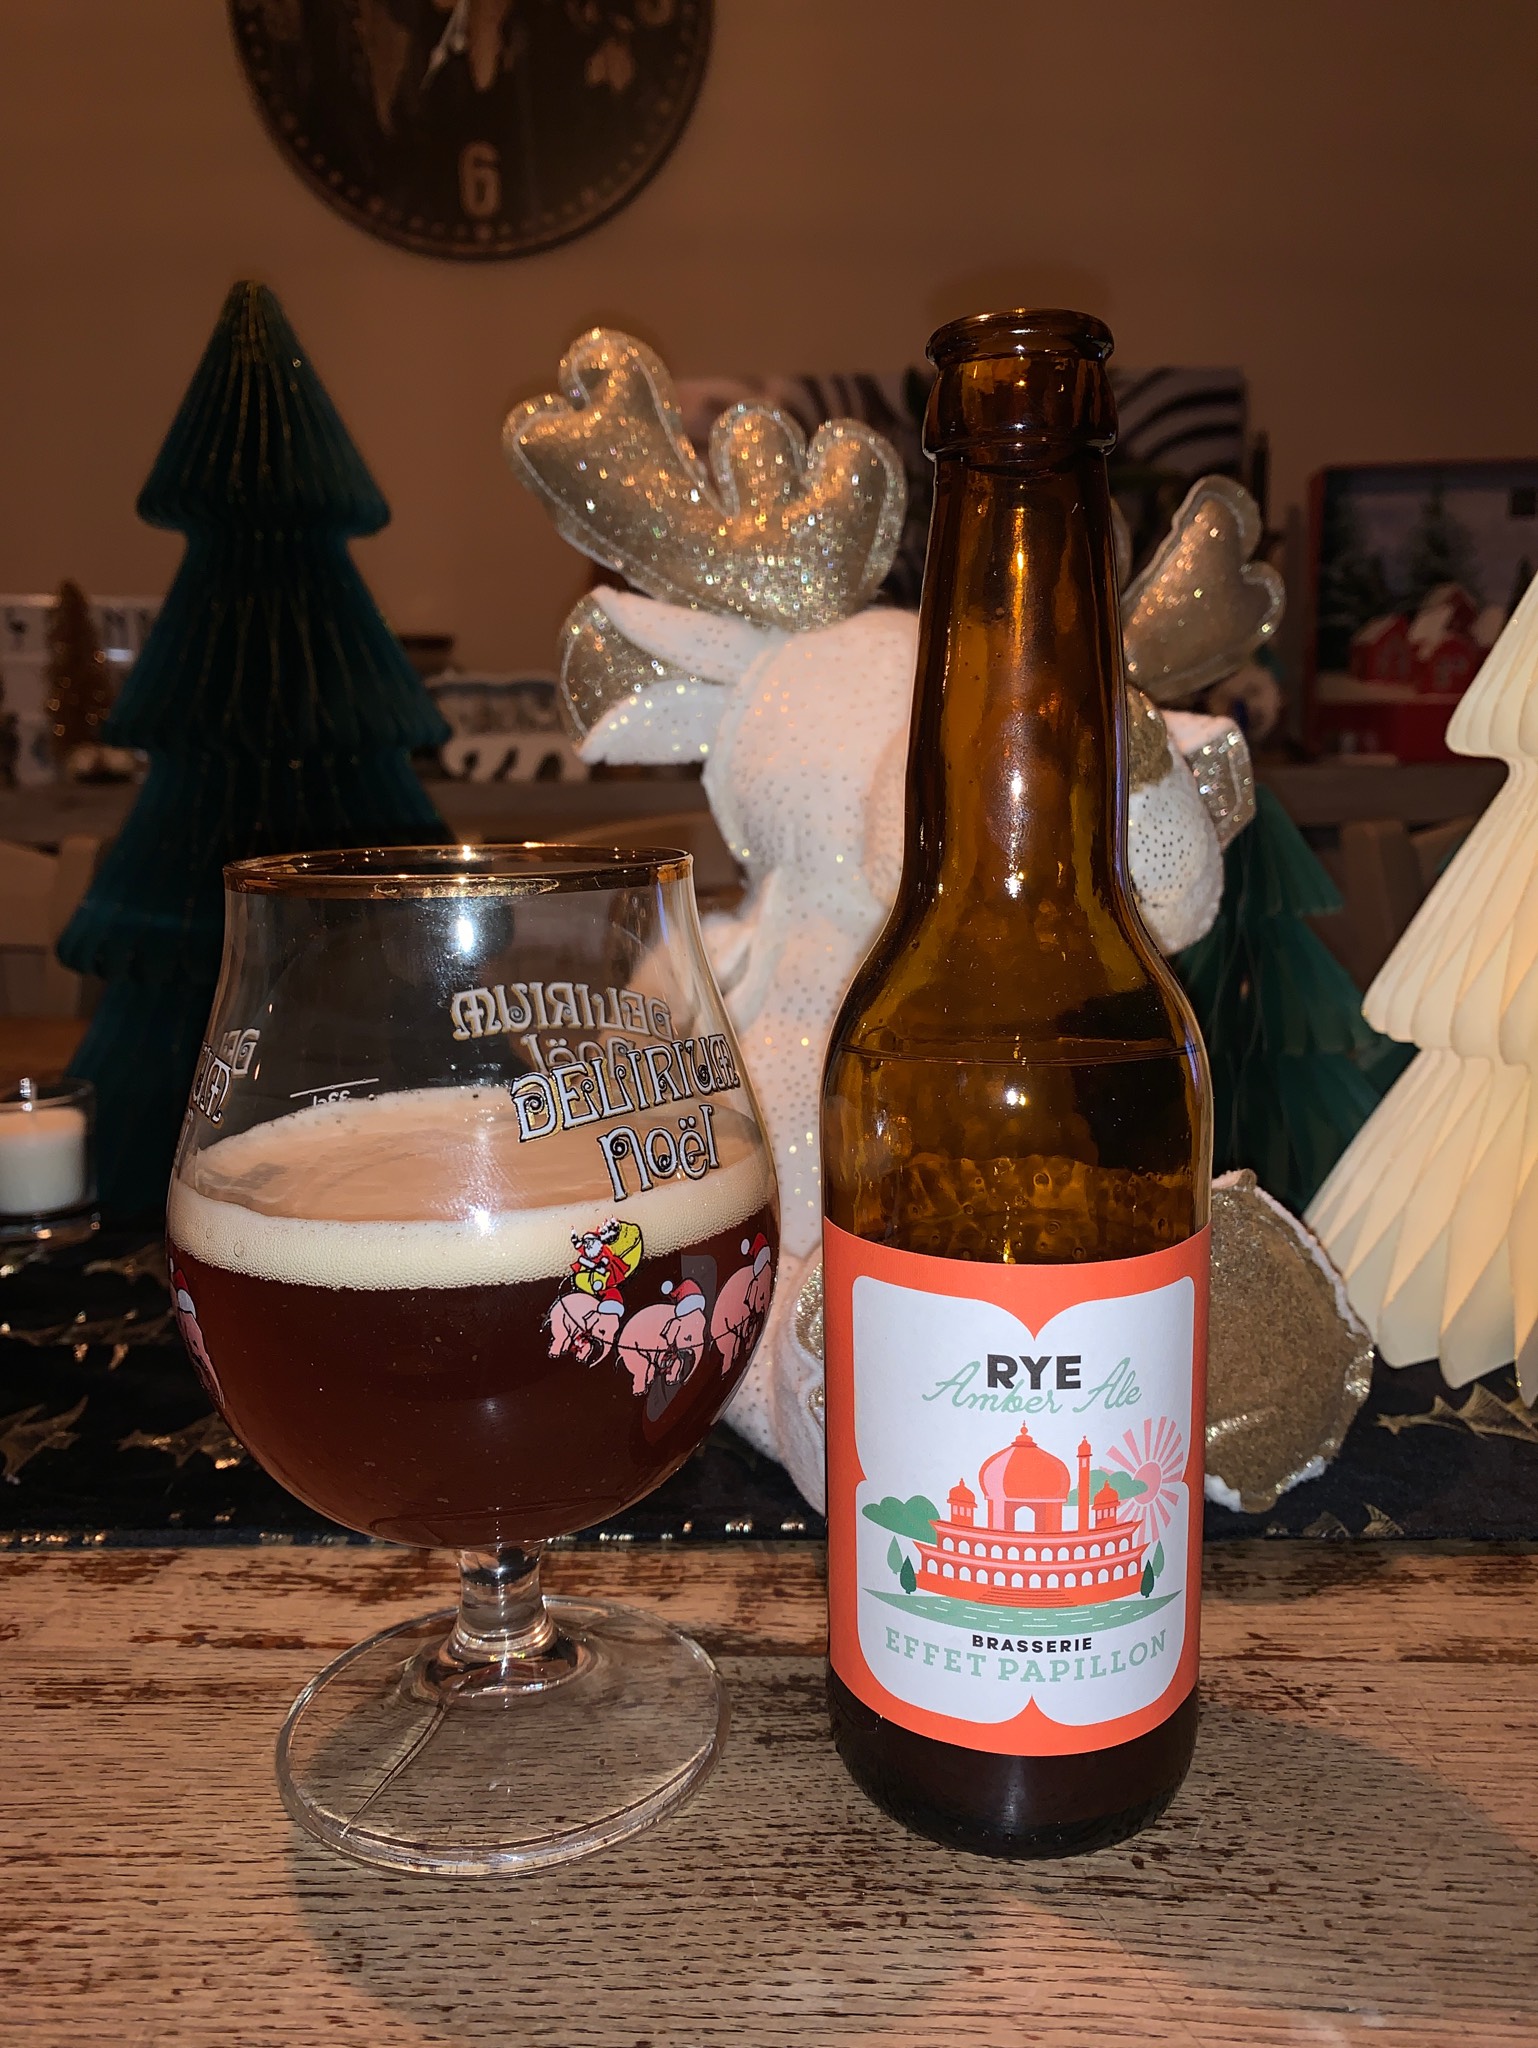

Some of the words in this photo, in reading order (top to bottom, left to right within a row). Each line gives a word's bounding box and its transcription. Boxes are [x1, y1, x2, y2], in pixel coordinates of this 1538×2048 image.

[460, 141, 501, 218] 6
[510, 1034, 740, 1142] DELIRIUM
[922, 1360, 1063, 1414] Amber
[1072, 1356, 1142, 1413] Ale
[987, 1353, 1081, 1390] RYE
[885, 1626, 986, 1677] EFFET
[998, 1629, 1166, 1682] PAPILLON
[972, 1634, 1092, 1653] BRASSERIE
